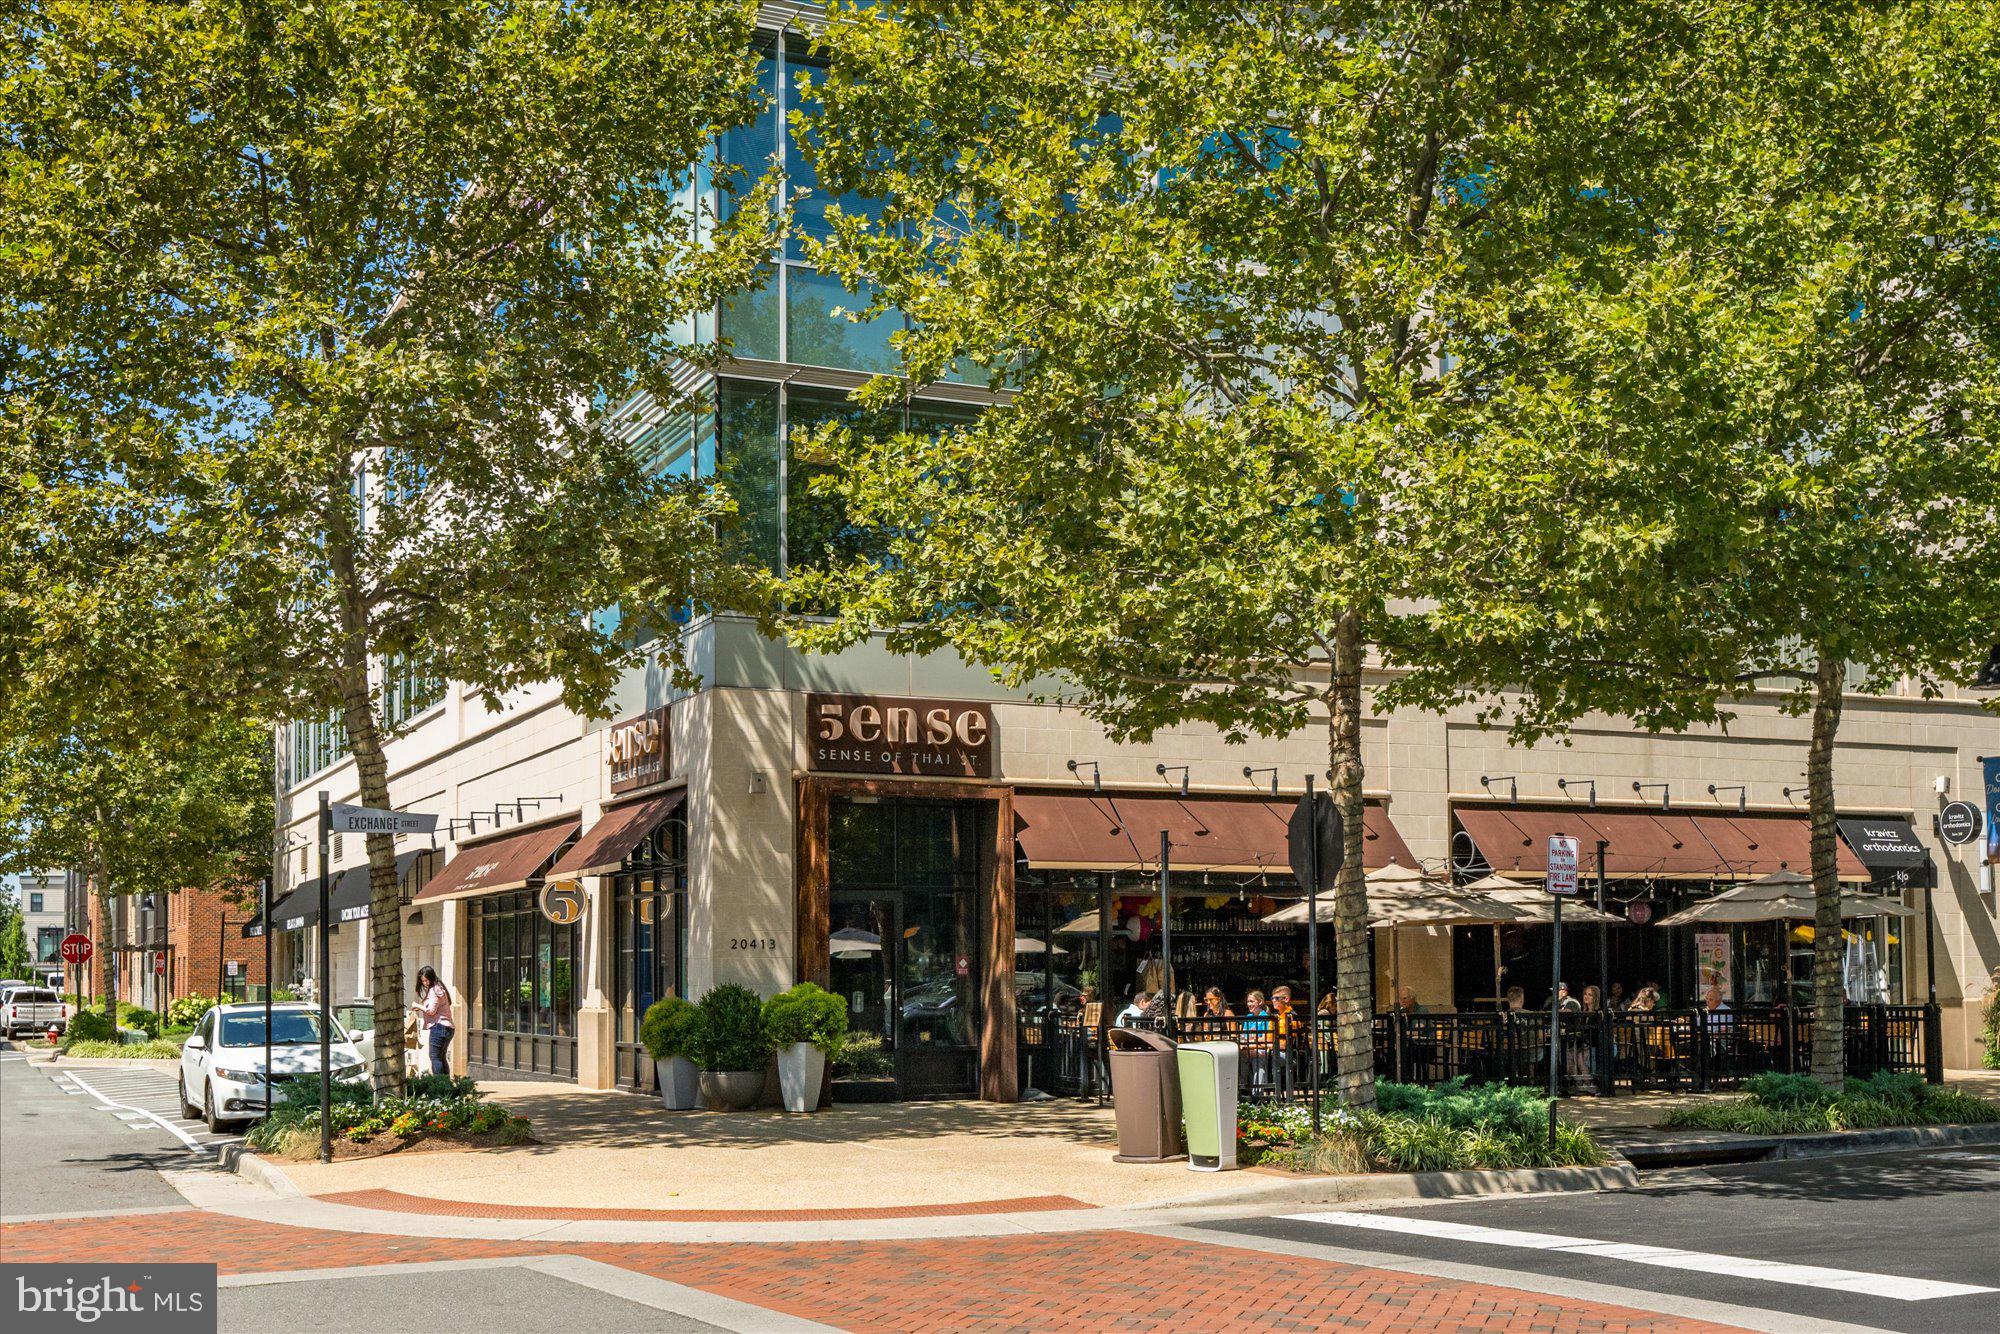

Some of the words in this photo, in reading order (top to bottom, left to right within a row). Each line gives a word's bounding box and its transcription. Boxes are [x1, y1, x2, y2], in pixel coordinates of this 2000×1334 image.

[819, 749, 872, 762] SENSE
[881, 751, 901, 762] OF
[911, 753, 950, 765] THAI
[348, 816, 399, 830] EXCHANGE
[401, 820, 419, 828] STREET
[1863, 827, 1899, 838] kravitz
[1559, 840, 1567, 848] NO
[1862, 842, 1921, 853] orthodontics
[1551, 849, 1575, 858] PARKING
[1549, 863, 1575, 871] STANDING
[1549, 872, 1561, 881] FIRE
[1562, 873, 1576, 882] LANE
[63, 943, 91, 956] STOP
[730, 938, 776, 950] 20413
